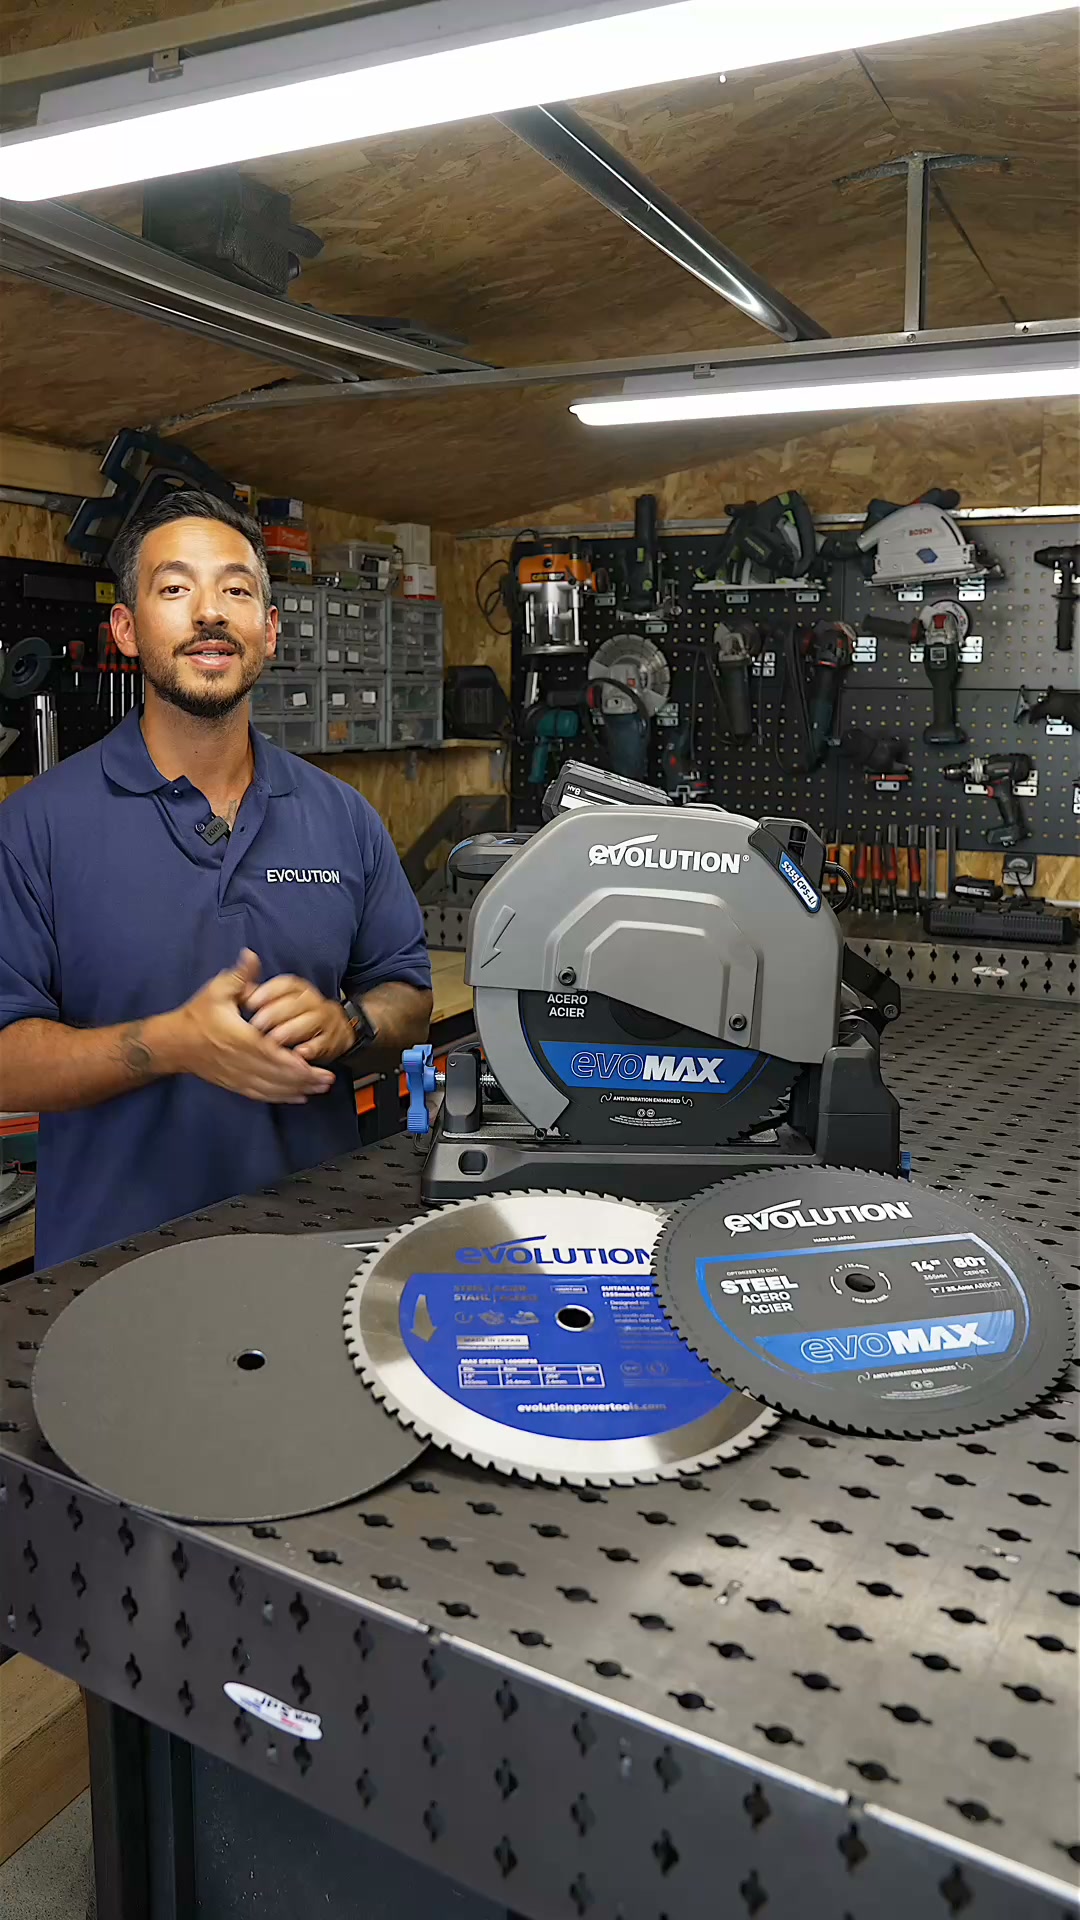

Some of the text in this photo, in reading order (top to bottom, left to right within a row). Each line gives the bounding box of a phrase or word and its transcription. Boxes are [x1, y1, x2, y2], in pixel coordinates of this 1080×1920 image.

[909, 528, 933, 537] BOSCH
[266, 868, 341, 884] EVOLUTION
[547, 994, 588, 1005] ACERO
[549, 1007, 585, 1018] ACIER
[613, 1095, 652, 1103] ANTI-VIBRATION
[952, 1256, 986, 1269] 80T
[726, 1269, 757, 1277] OPTIMIZED
[963, 1268, 990, 1277] CERMET
[720, 1276, 799, 1294] STEEL
[974, 1281, 1001, 1290] ARBOR
[742, 1292, 790, 1304] ACERO
[751, 1303, 794, 1315] ACIER
[872, 1364, 957, 1380] ANTI-VIBRATION ENHANCED
